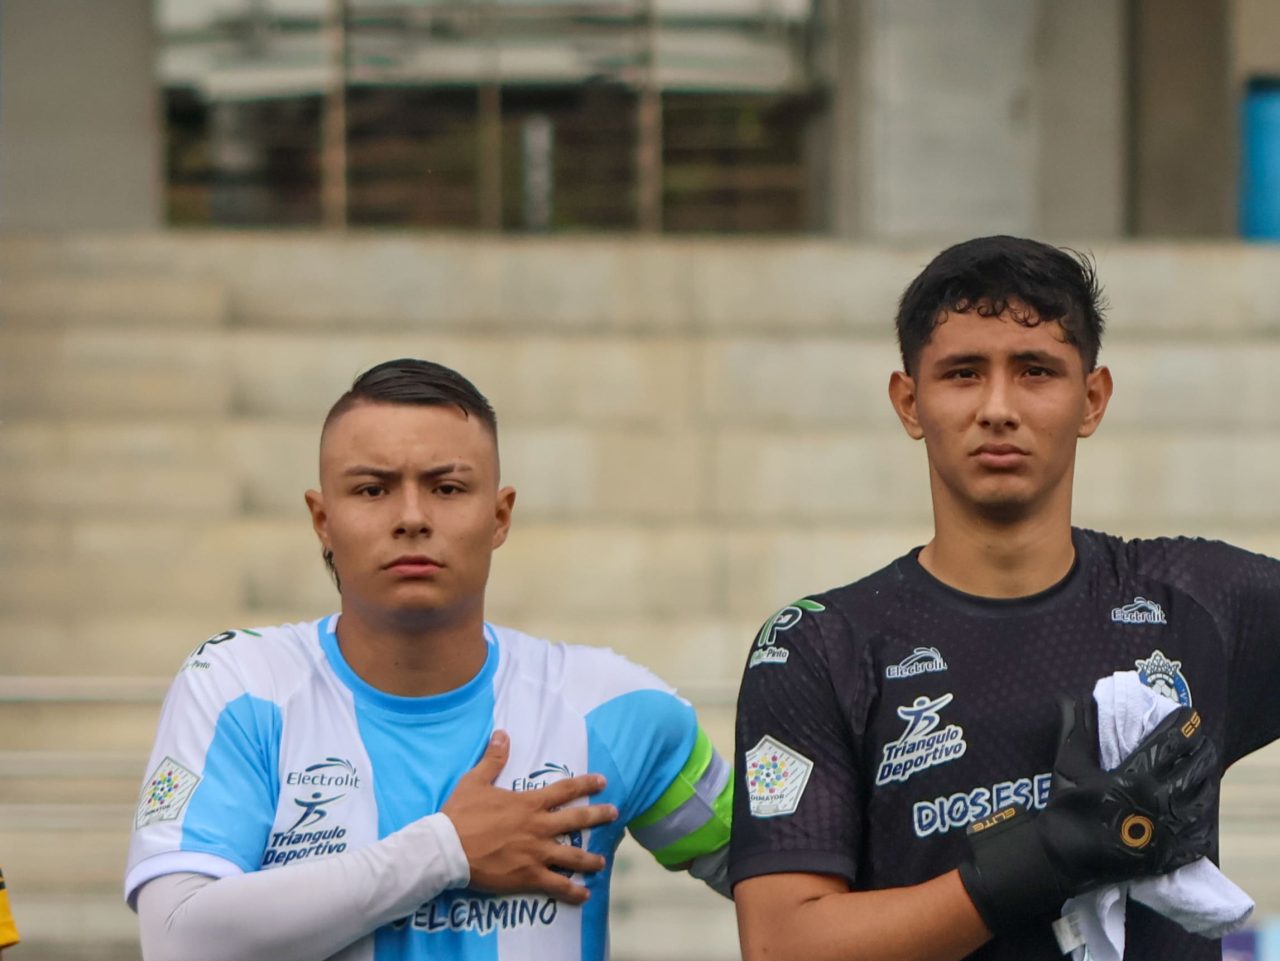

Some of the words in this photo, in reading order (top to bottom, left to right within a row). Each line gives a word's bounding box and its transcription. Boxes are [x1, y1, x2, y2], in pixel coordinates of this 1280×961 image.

[766, 649, 788, 659] Pinto
[885, 727, 959, 762] Triangulo
[879, 742, 962, 782] Deportivo
[286, 771, 360, 789] Electrolit
[915, 789, 991, 834] DIOS
[994, 780, 1033, 809] ES
[972, 807, 1016, 833] ELITE
[271, 826, 347, 848] Triangulo
[261, 841, 347, 867] Deportivo
[450, 898, 558, 933] CAMINO
